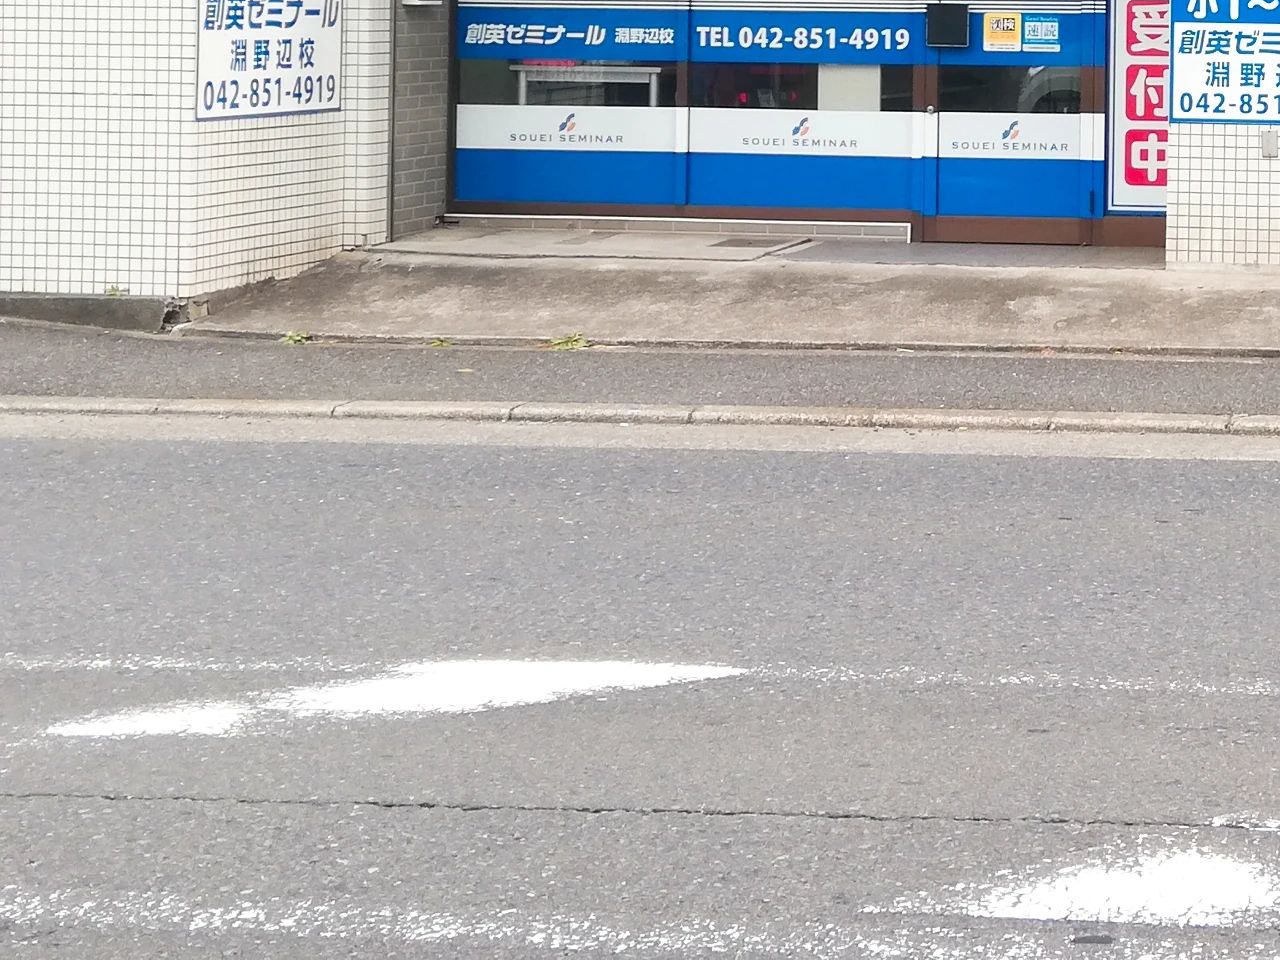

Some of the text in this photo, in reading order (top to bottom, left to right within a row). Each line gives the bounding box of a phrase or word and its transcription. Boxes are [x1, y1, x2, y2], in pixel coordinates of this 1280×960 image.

[464, 23, 910, 50] 創英ゼミナール 淵野辺校 TEL 042-851-4919
[230, 38, 316, 71] 淵野辺校
[204, 76, 336, 111] 042-851-4919
[509, 133, 624, 144] SOUEI SEMINAR
[742, 137, 858, 148] SOUEI SEMINAR
[951, 141, 1069, 152] SOUEI SEMINAR
